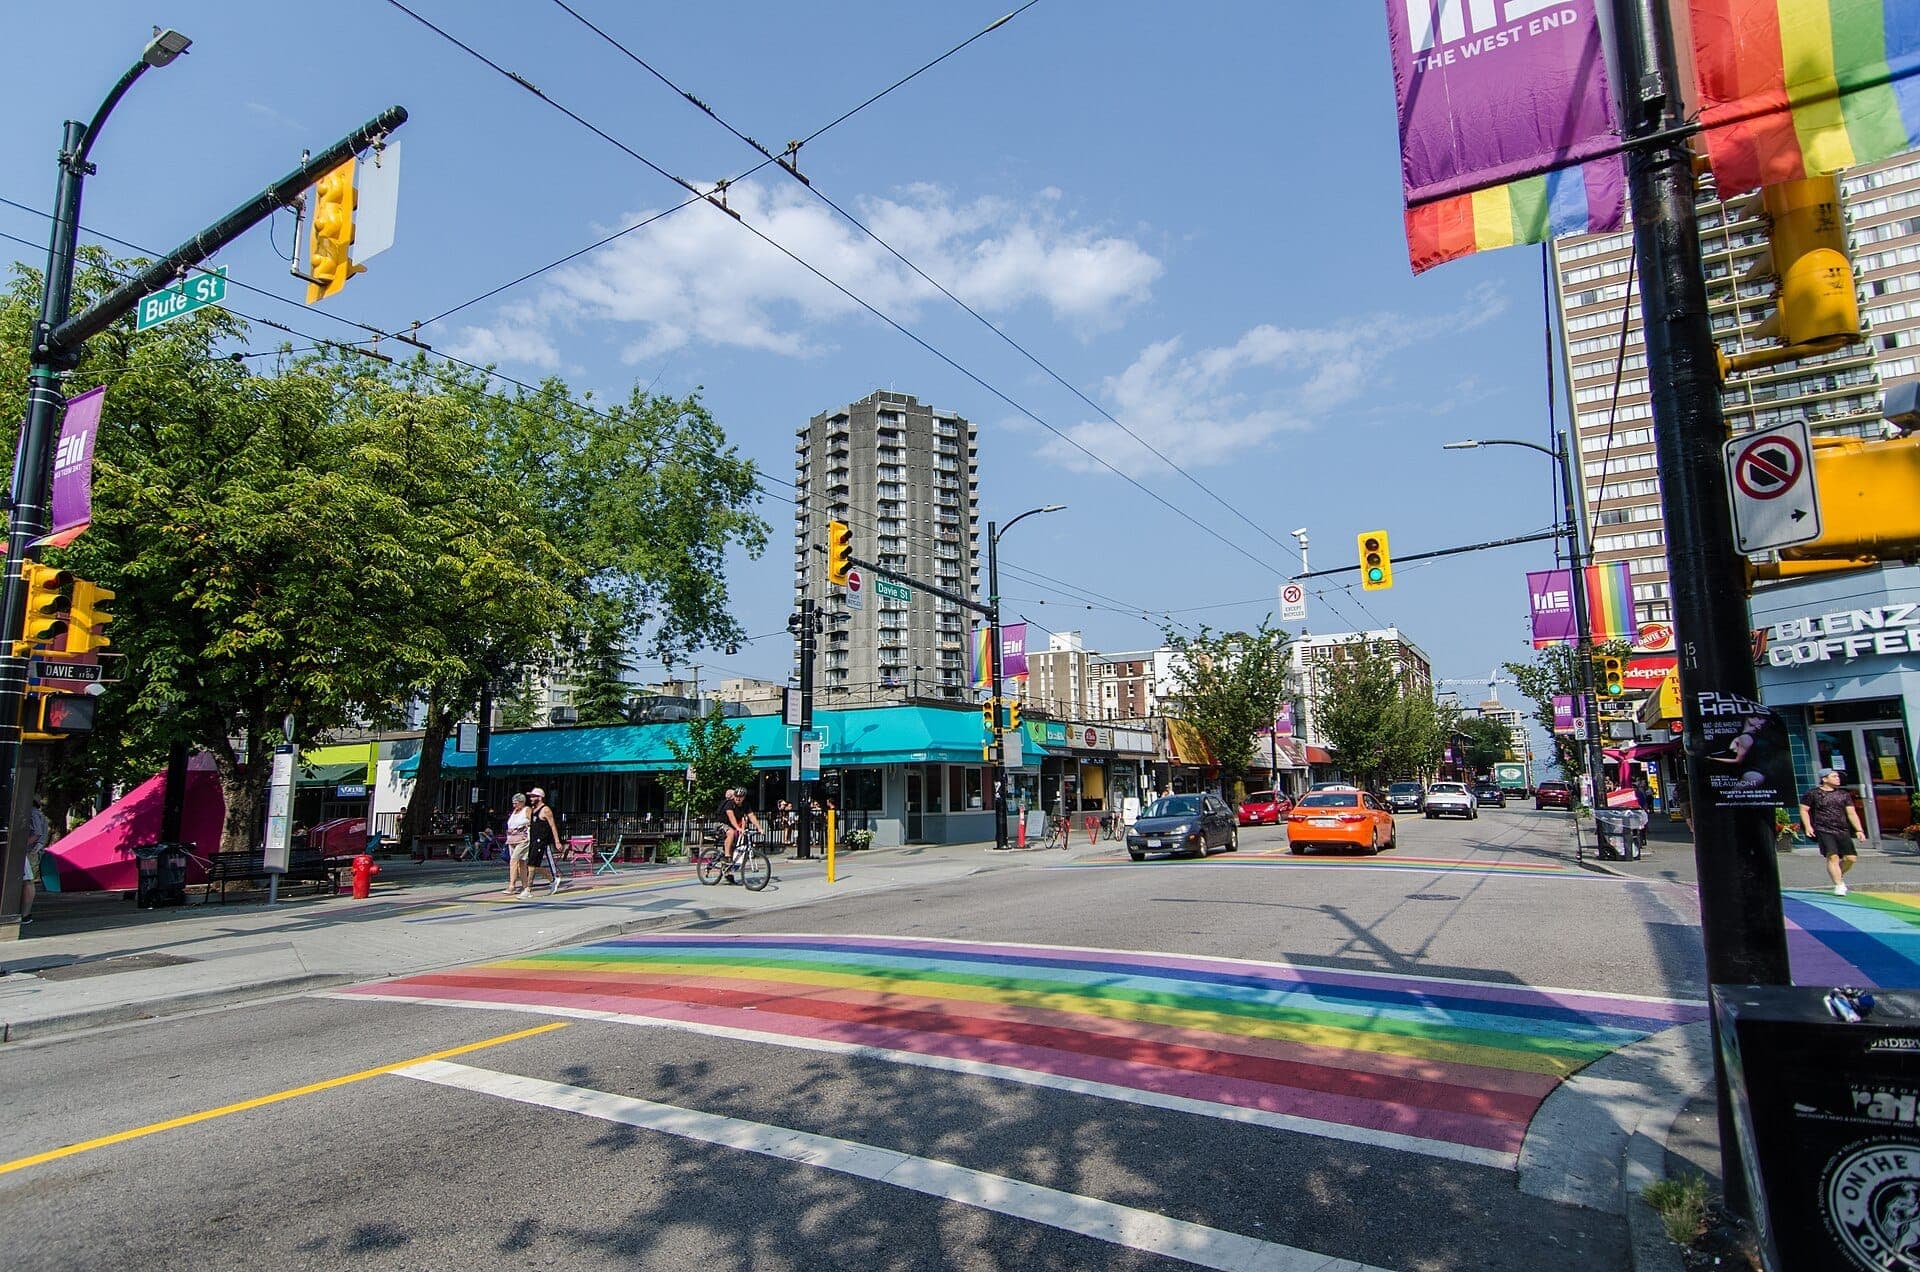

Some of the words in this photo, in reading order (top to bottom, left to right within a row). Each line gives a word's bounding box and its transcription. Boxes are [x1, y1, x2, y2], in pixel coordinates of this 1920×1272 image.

[1412, 49, 1457, 73] THE
[1460, 26, 1523, 58] WEST
[1529, 9, 1578, 37] END
[145, 293, 188, 323] Bute
[196, 278, 217, 301] St
[878, 583, 898, 596] Davie
[900, 588, 908, 599] St
[1775, 603, 1920, 641] BLENZ
[1638, 630, 1660, 646] DAVIE
[1660, 627, 1671, 637] ST
[45, 664, 74, 678] DAVIE
[1624, 667, 1670, 680] depen
[1700, 702, 1771, 716] HAUS
[1842, 1171, 1867, 1201] ON
[1859, 1154, 1908, 1176] THE
